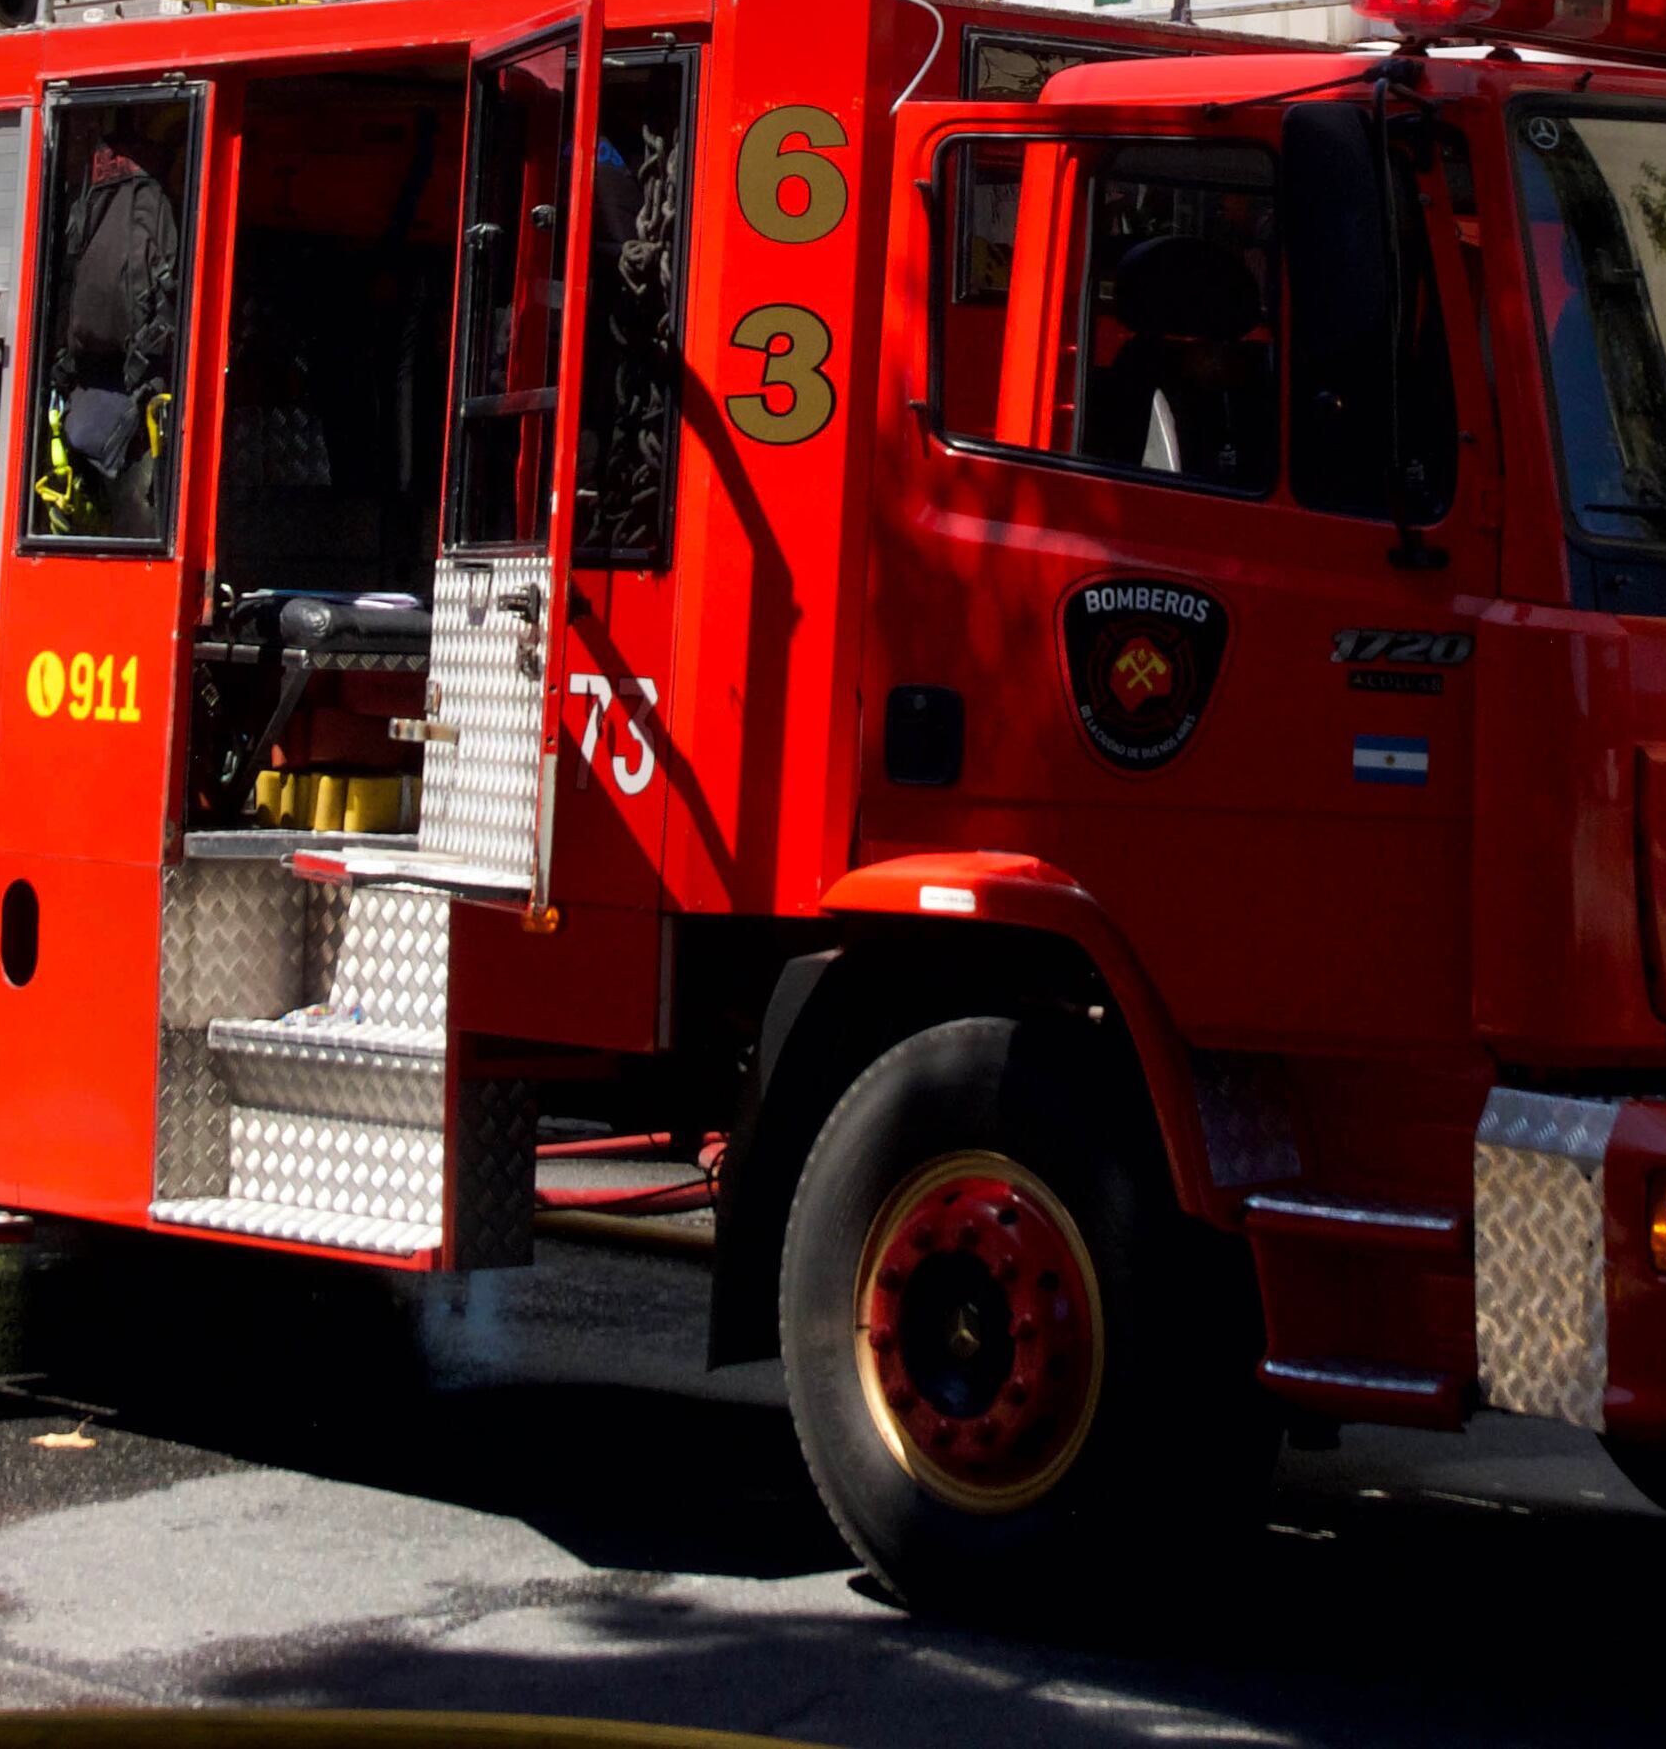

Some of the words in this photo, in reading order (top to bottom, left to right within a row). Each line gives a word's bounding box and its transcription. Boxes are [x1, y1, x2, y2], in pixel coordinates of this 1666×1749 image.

[1084, 587, 1210, 623] BOMBEROS
[1330, 628, 1477, 665] 1720
[68, 651, 141, 722] 911
[569, 672, 659, 795] 73
